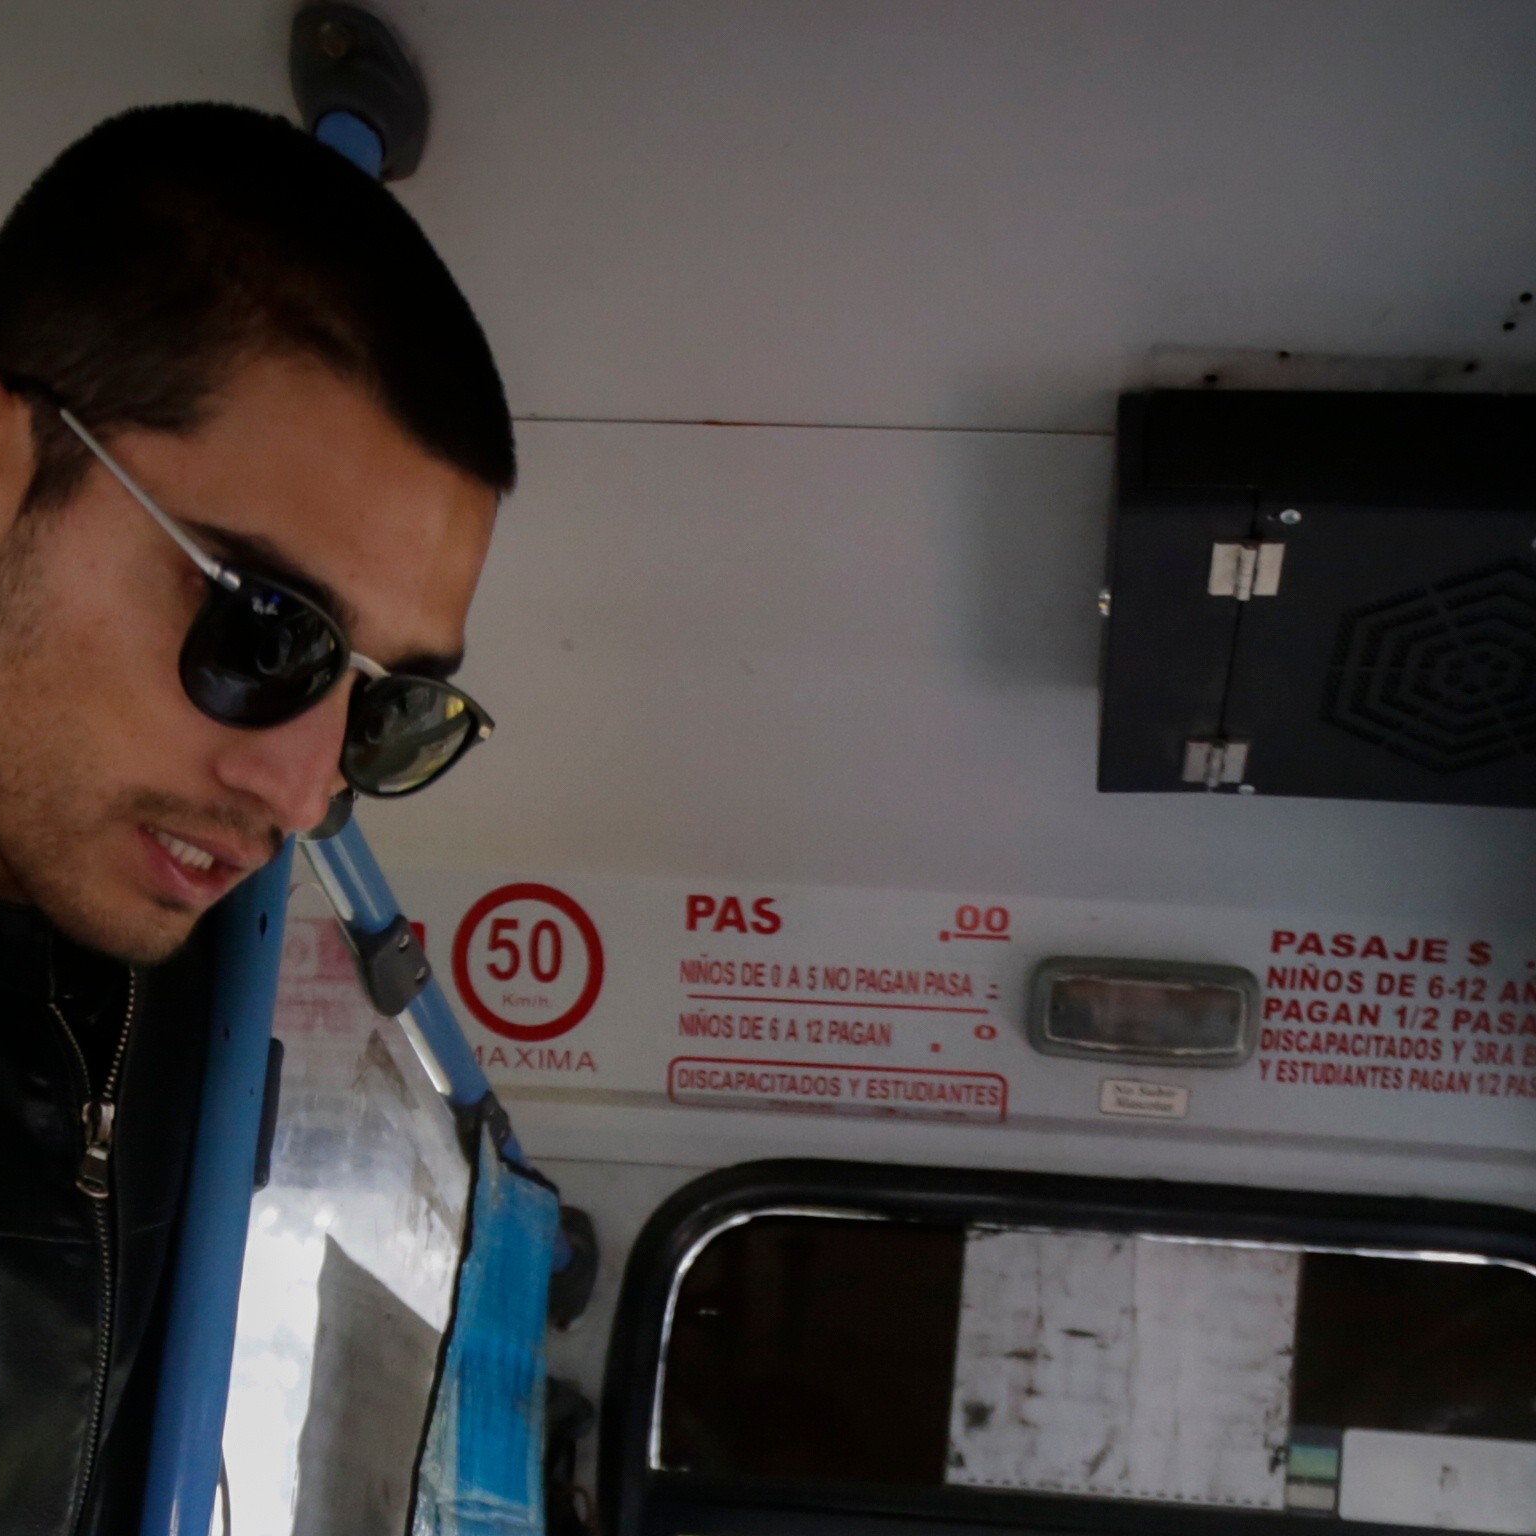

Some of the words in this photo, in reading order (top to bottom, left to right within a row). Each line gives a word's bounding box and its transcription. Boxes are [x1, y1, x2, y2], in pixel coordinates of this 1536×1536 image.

[685, 894, 782, 935] PAS
[486, 917, 562, 984] 50
[1270, 930, 1449, 964] PASAJE
[679, 953, 735, 984] NIÑOS
[741, 962, 765, 988] DE
[787, 965, 801, 990] A
[807, 966, 818, 990] 5
[824, 967, 851, 991] NO
[855, 968, 920, 995] PAGAN
[1267, 962, 1364, 995] NIÑOS
[1376, 972, 1416, 999] DE
[1428, 975, 1488, 1002] 6-12
[678, 1008, 733, 1038] NIÑOS
[739, 1016, 764, 1041] DE
[769, 1017, 779, 1041] 6
[786, 1019, 798, 1041] A
[806, 1020, 823, 1044] 12
[828, 1021, 893, 1046] PAGAN
[1264, 998, 1382, 1028] PAGAN
[1394, 1006, 1440, 1031] 1/2
[1260, 1028, 1443, 1062] DISCAPACITADOS
[1452, 1041, 1466, 1062] Y
[1472, 1041, 1515, 1066] 3RA
[678, 1067, 842, 1097] DISCAPACITADOS
[849, 1078, 861, 1096] Y
[866, 1079, 1000, 1106] ESTUDIANTES
[1259, 1059, 1272, 1081] Y
[1276, 1061, 1405, 1091] ESTUDIANTES
[1408, 1068, 1472, 1096] PAGAN
